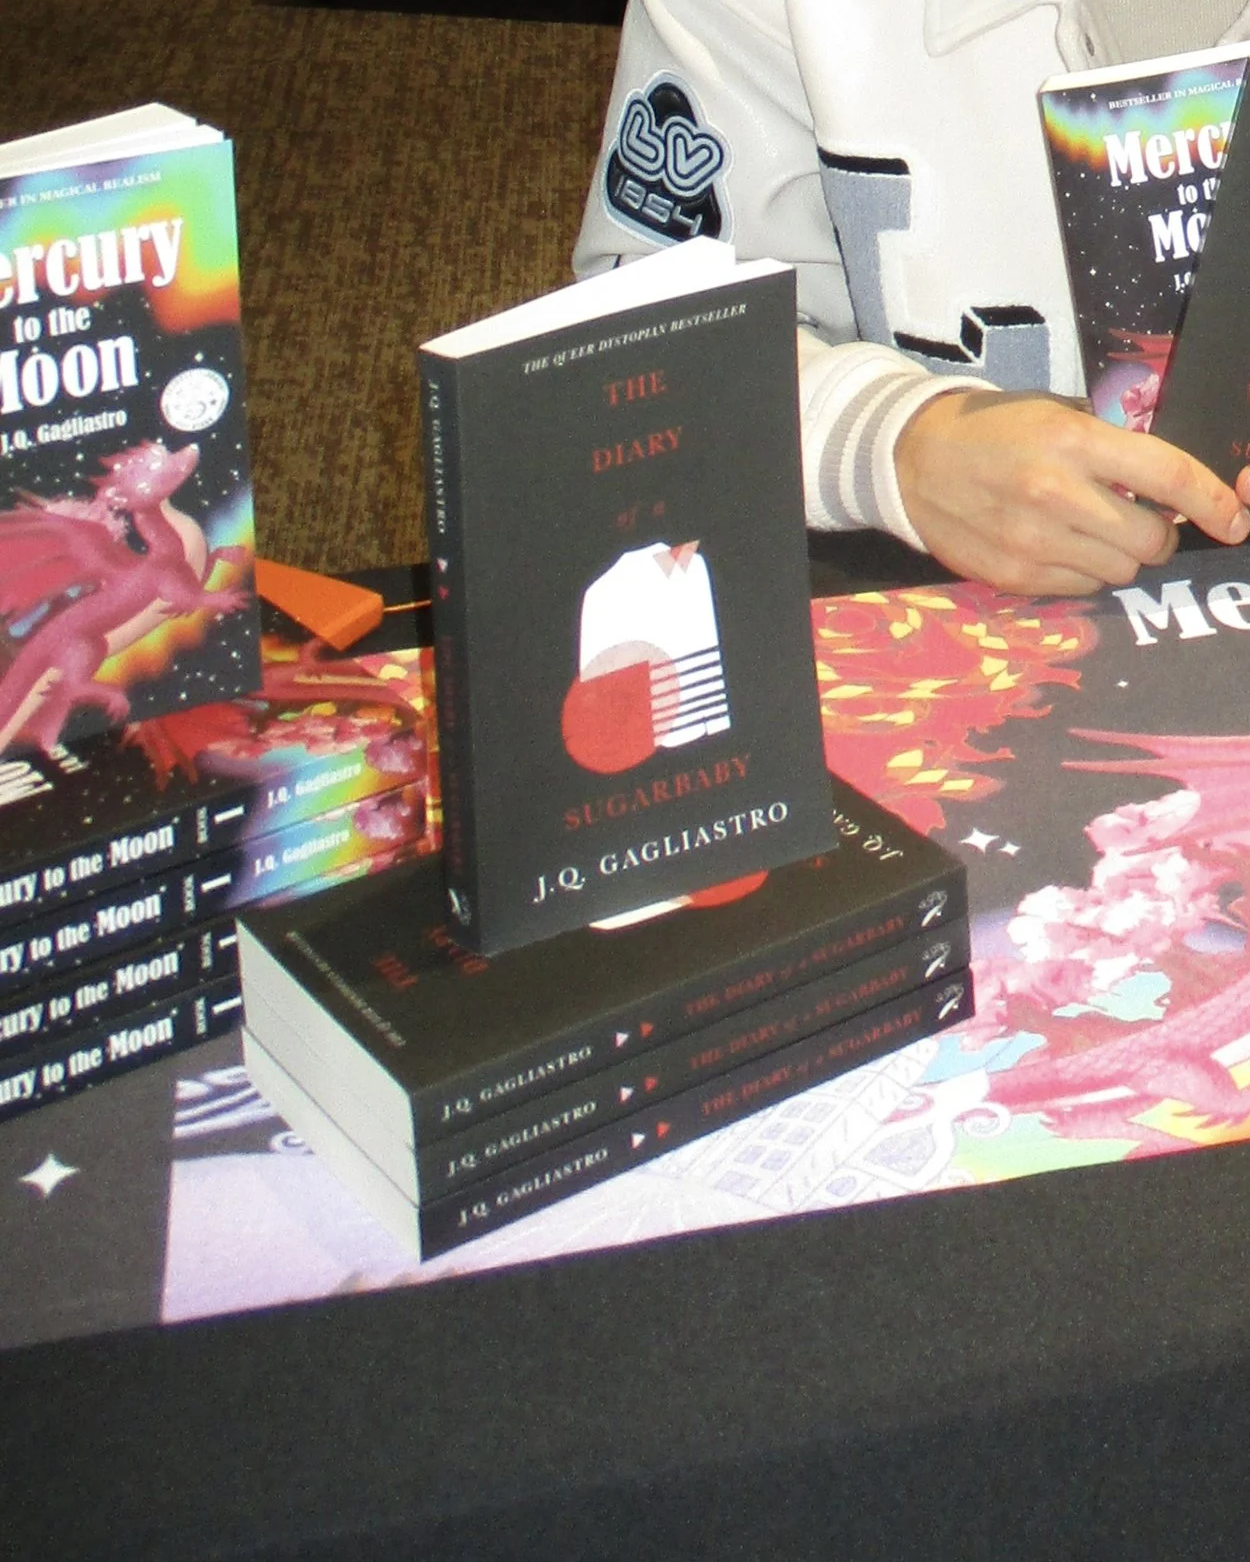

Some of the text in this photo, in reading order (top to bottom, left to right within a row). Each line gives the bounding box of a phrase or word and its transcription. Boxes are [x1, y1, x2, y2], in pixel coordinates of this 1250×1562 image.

[1108, 80, 1235, 110] BESTSELLER IN MAGICAL
[20, 193, 37, 206] IN
[1176, 182, 1198, 205] to
[13, 306, 91, 344] to the
[522, 302, 748, 375] THE QUEER DYSTOPIAN BESTSELLER
[602, 370, 667, 407] THE
[592, 426, 684, 474] DIARY
[565, 753, 750, 830] SUGARBABY
[44, 865, 65, 891] to
[69, 852, 103, 882] the
[109, 824, 174, 868] Moon
[534, 801, 790, 902] J.Q. GAGLIASTRO
[30, 936, 52, 961] to
[56, 922, 91, 952] the
[96, 893, 162, 937] Moon
[49, 996, 71, 1021] to
[75, 981, 109, 1010] the
[116, 951, 180, 994] Moon
[42, 1017, 174, 1087] to the Moon
[441, 1044, 593, 1123] J.Q. GAGLIASTRO
[447, 1100, 598, 1179] J.Q. GAGLIASTRO
[496, 1147, 609, 1207] GAGLIASTRO
